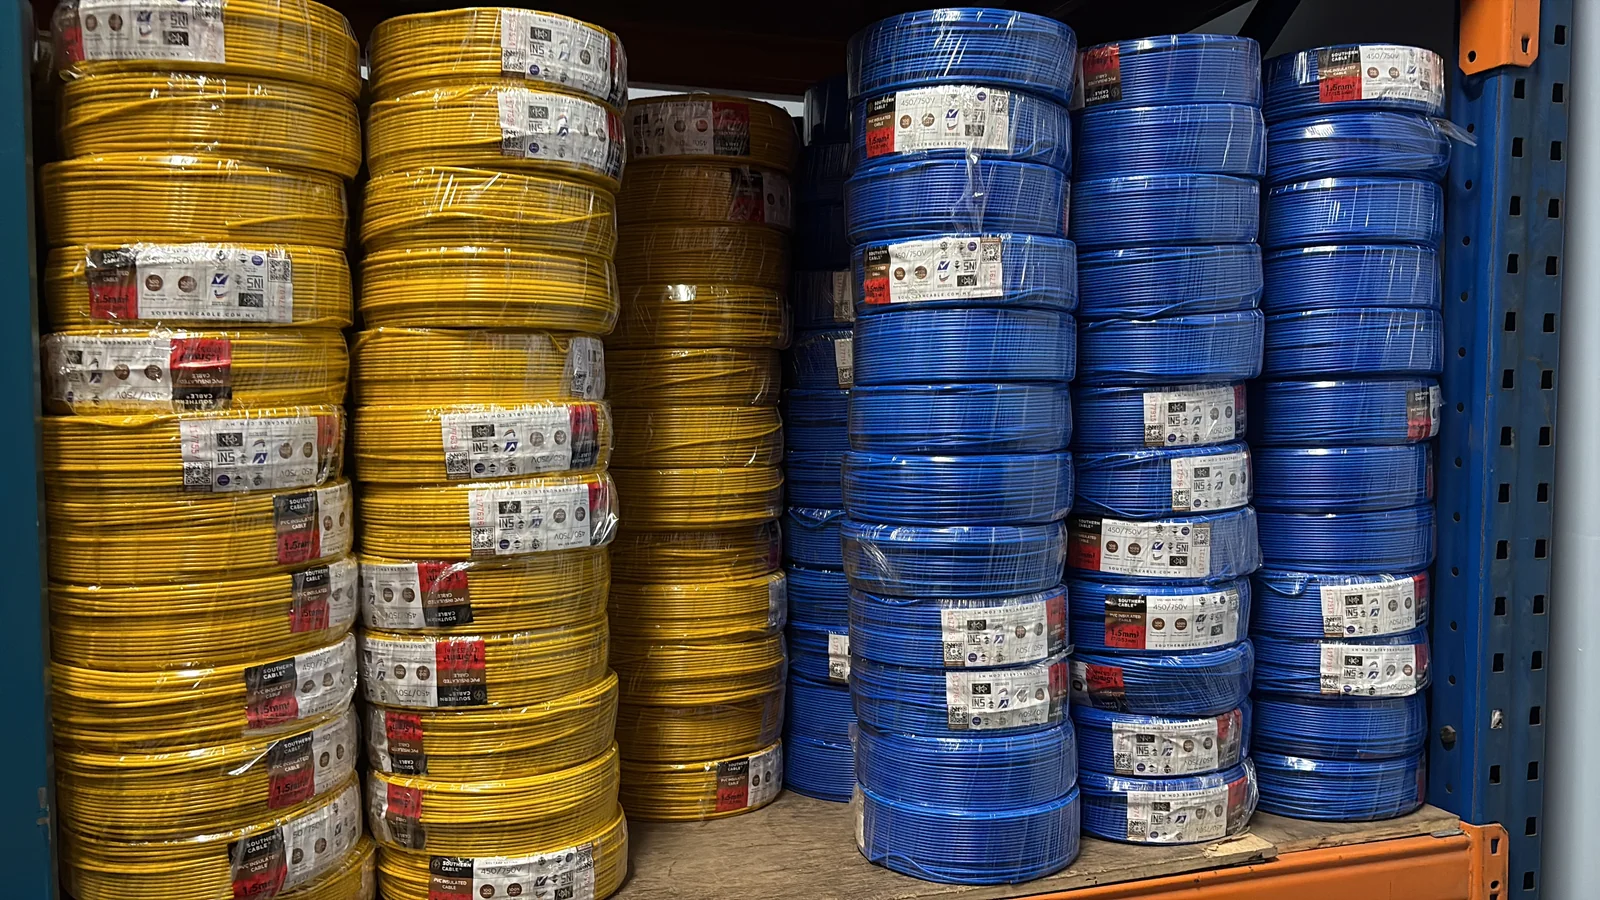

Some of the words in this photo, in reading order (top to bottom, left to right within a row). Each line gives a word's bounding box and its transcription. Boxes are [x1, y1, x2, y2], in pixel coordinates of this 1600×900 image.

[1366, 52, 1400, 60] 450/750V
[895, 250, 927, 259] 450/750V
[963, 261, 977, 271] SNI
[246, 277, 264, 290] SNI
[174, 398, 213, 406] SOUTHERN
[1167, 416, 1180, 425] SNI
[472, 441, 489, 453] SNI
[217, 452, 235, 463] SNI
[1193, 481, 1205, 490] SNI
[289, 496, 315, 505] SOUTHERN
[289, 503, 307, 511] CABLE
[499, 518, 514, 529] SNI
[553, 530, 586, 541] 450/750V
[1107, 526, 1142, 535] 450/750V
[1176, 543, 1189, 553] SNI
[305, 567, 328, 576] SOUTHERN
[305, 574, 321, 582] CABLE
[1345, 608, 1359, 618] SNI
[1111, 627, 1140, 639] 1.5mm²
[967, 634, 981, 644] SNI
[263, 663, 294, 675] SOUTHERN
[1343, 668, 1357, 678] SNI
[263, 671, 283, 680] CABLE
[263, 682, 292, 694] INSULATED
[394, 689, 430, 698] 450/750V
[971, 698, 985, 707] SNI
[284, 736, 312, 749] SOUTHERN
[284, 745, 301, 754] CABLE
[1136, 746, 1149, 756] SNI
[284, 763, 300, 772] CABLE
[1150, 814, 1164, 824] SNI
[247, 843, 269, 854] CABLE
[250, 863, 268, 873] CABLE
[480, 866, 522, 875] 450/750V
[442, 878, 467, 886] INSULATED
